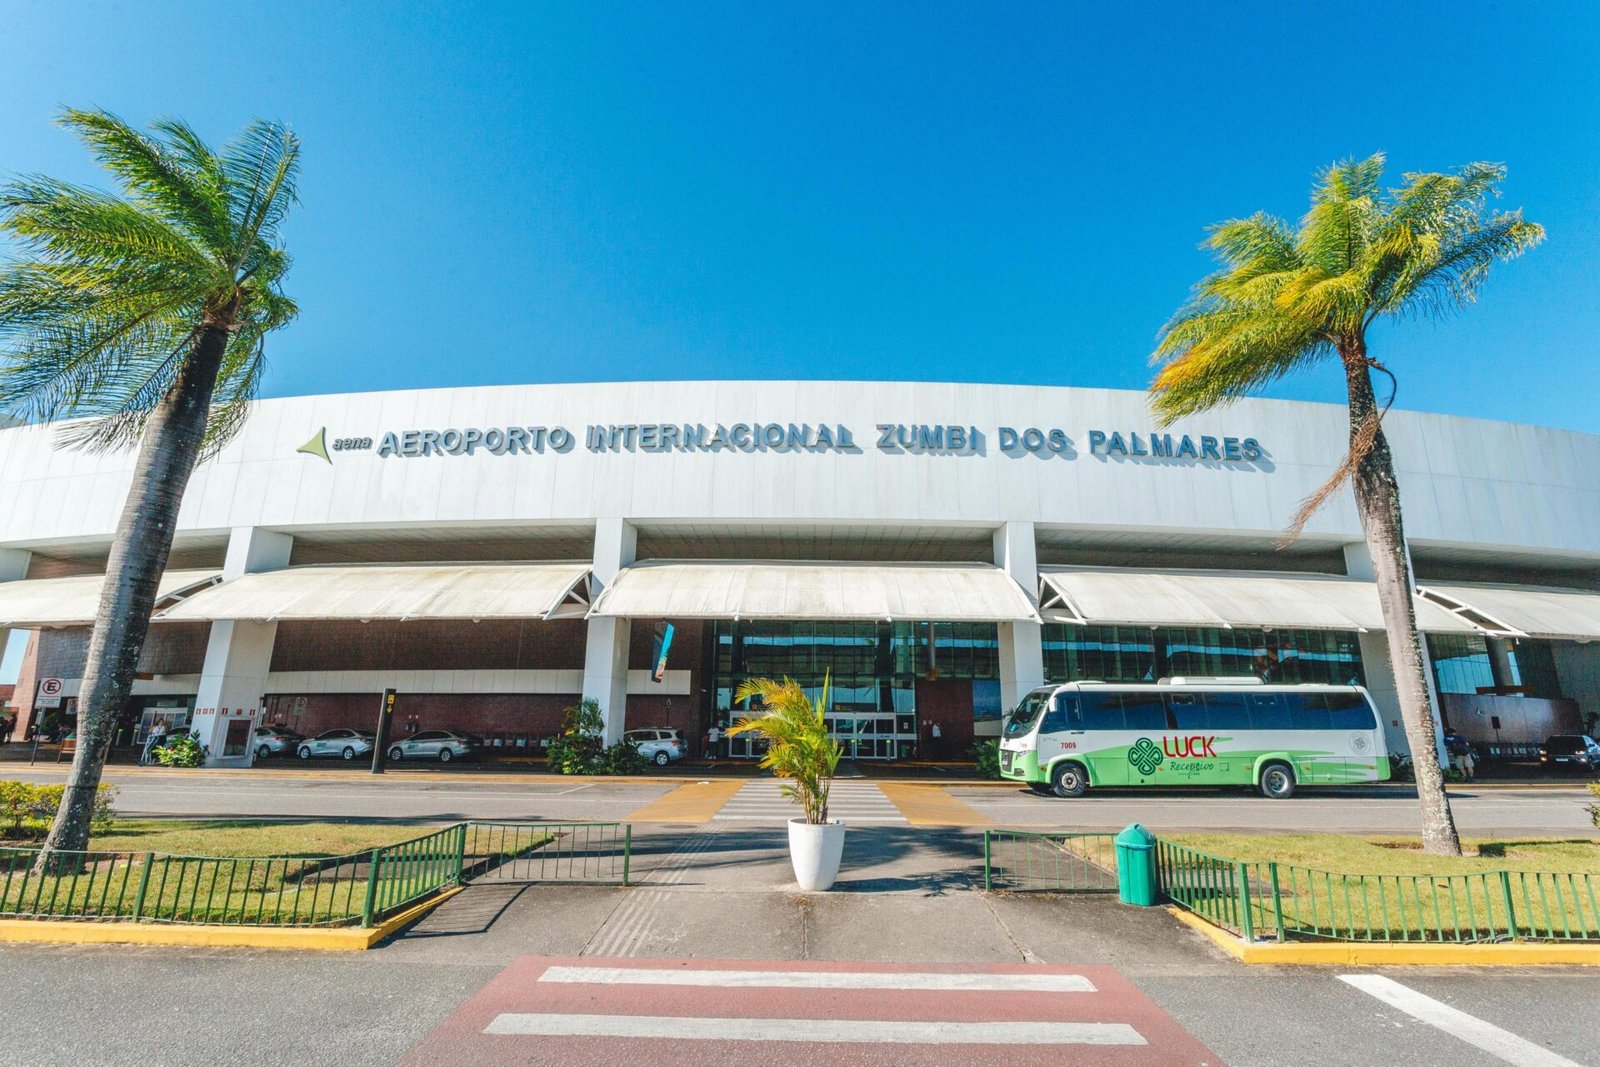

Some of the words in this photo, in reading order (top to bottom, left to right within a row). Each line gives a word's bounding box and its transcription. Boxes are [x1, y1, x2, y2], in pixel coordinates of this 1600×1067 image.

[332, 436, 373, 451] aena
[378, 426, 571, 454] AEROPORTO
[585, 423, 859, 450] INTERNACIONAL
[876, 423, 978, 450] ZUMBI
[999, 426, 1068, 452] DOS
[1089, 429, 1262, 461] PALMARES
[1163, 735, 1217, 758] LUCK
[1170, 761, 1214, 778] Receptivo
